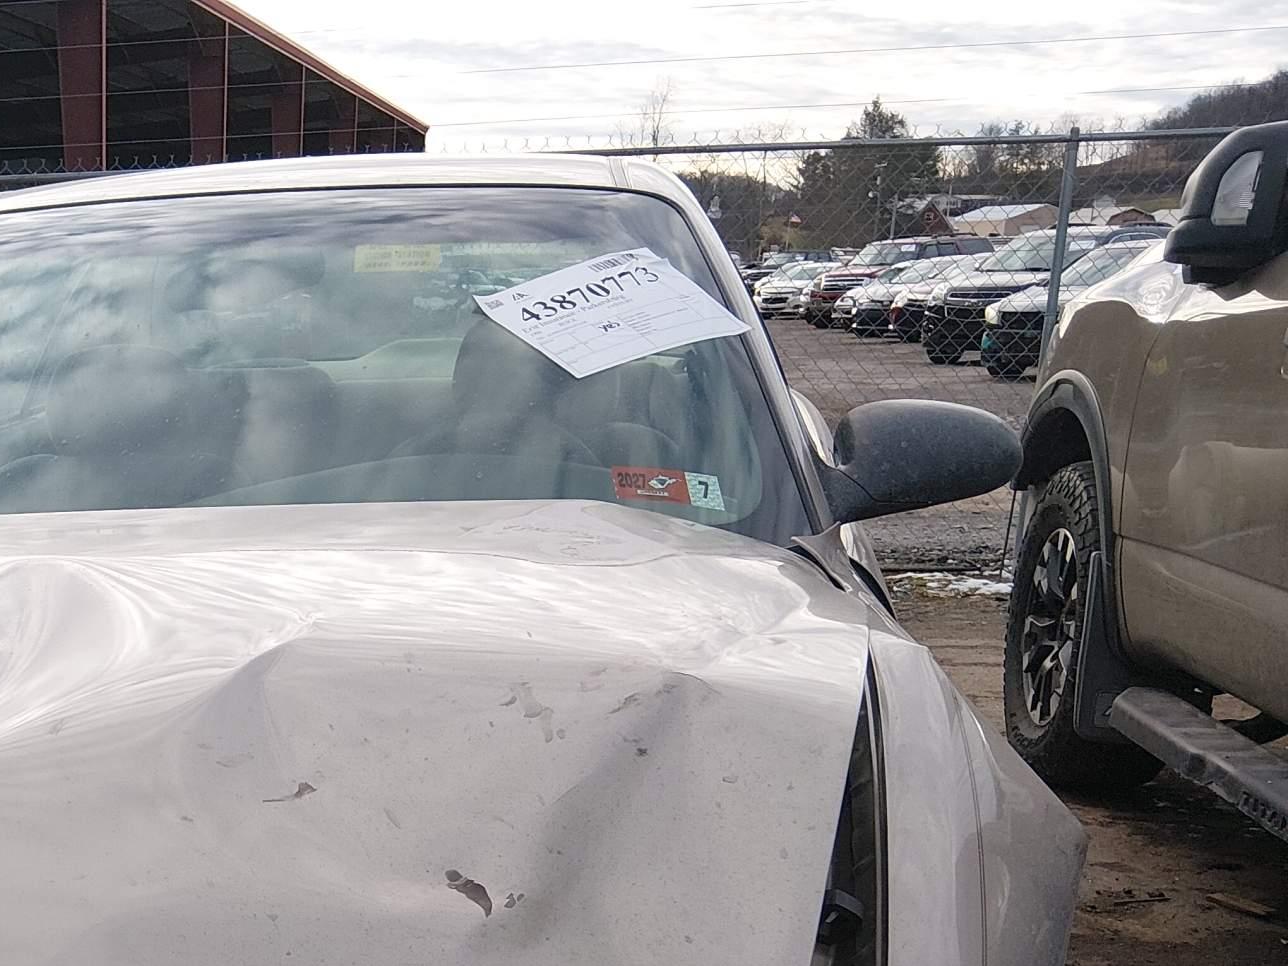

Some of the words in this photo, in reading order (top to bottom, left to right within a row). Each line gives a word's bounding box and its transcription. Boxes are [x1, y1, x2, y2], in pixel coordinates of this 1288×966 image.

[520, 266, 660, 322] 43870773
[617, 472, 646, 489] 2027
[698, 480, 710, 499] 7
